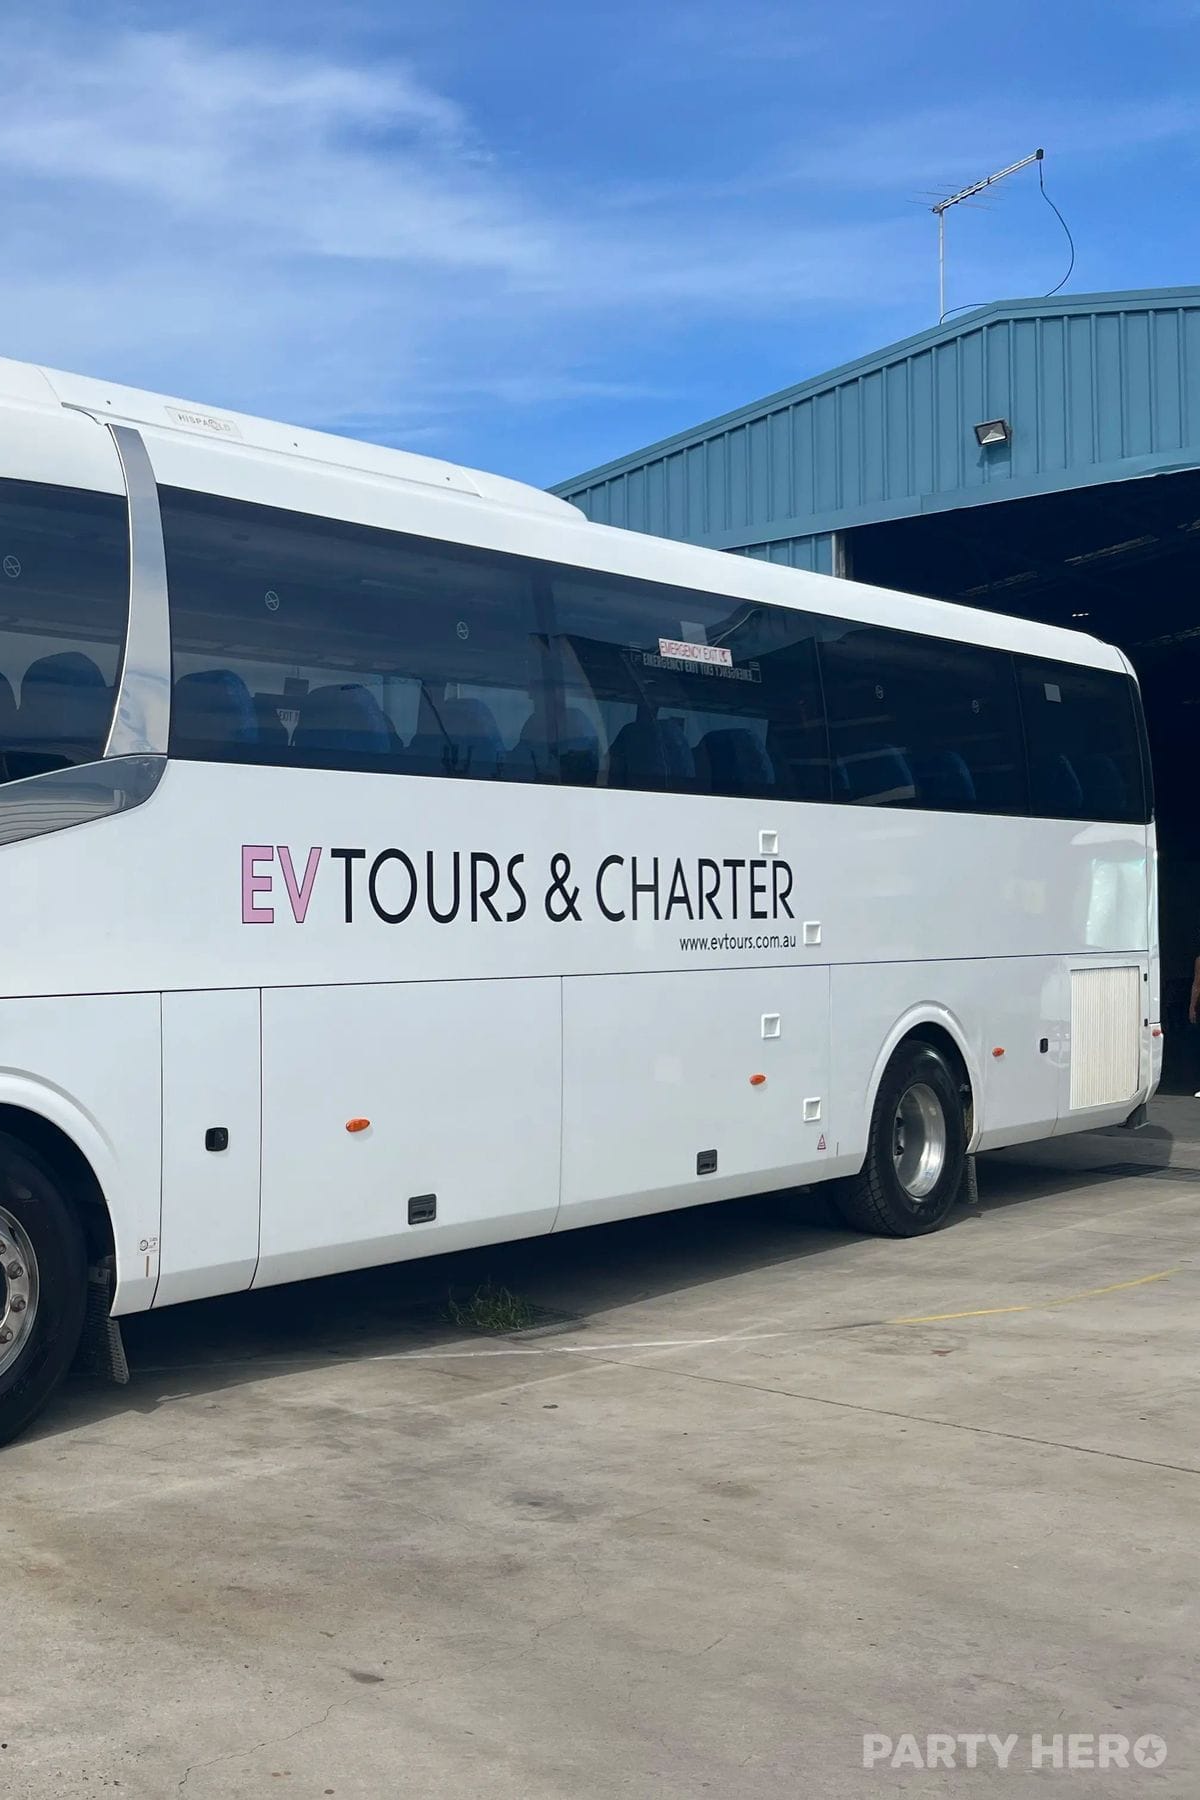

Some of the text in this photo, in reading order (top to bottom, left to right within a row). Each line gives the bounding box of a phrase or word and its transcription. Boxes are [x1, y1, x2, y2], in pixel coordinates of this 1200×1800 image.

[660, 640, 699, 659] EMERGENCY
[241, 845, 796, 924] EV TOURS & CHARTER
[679, 933, 796, 951] www.evtours.com.au
